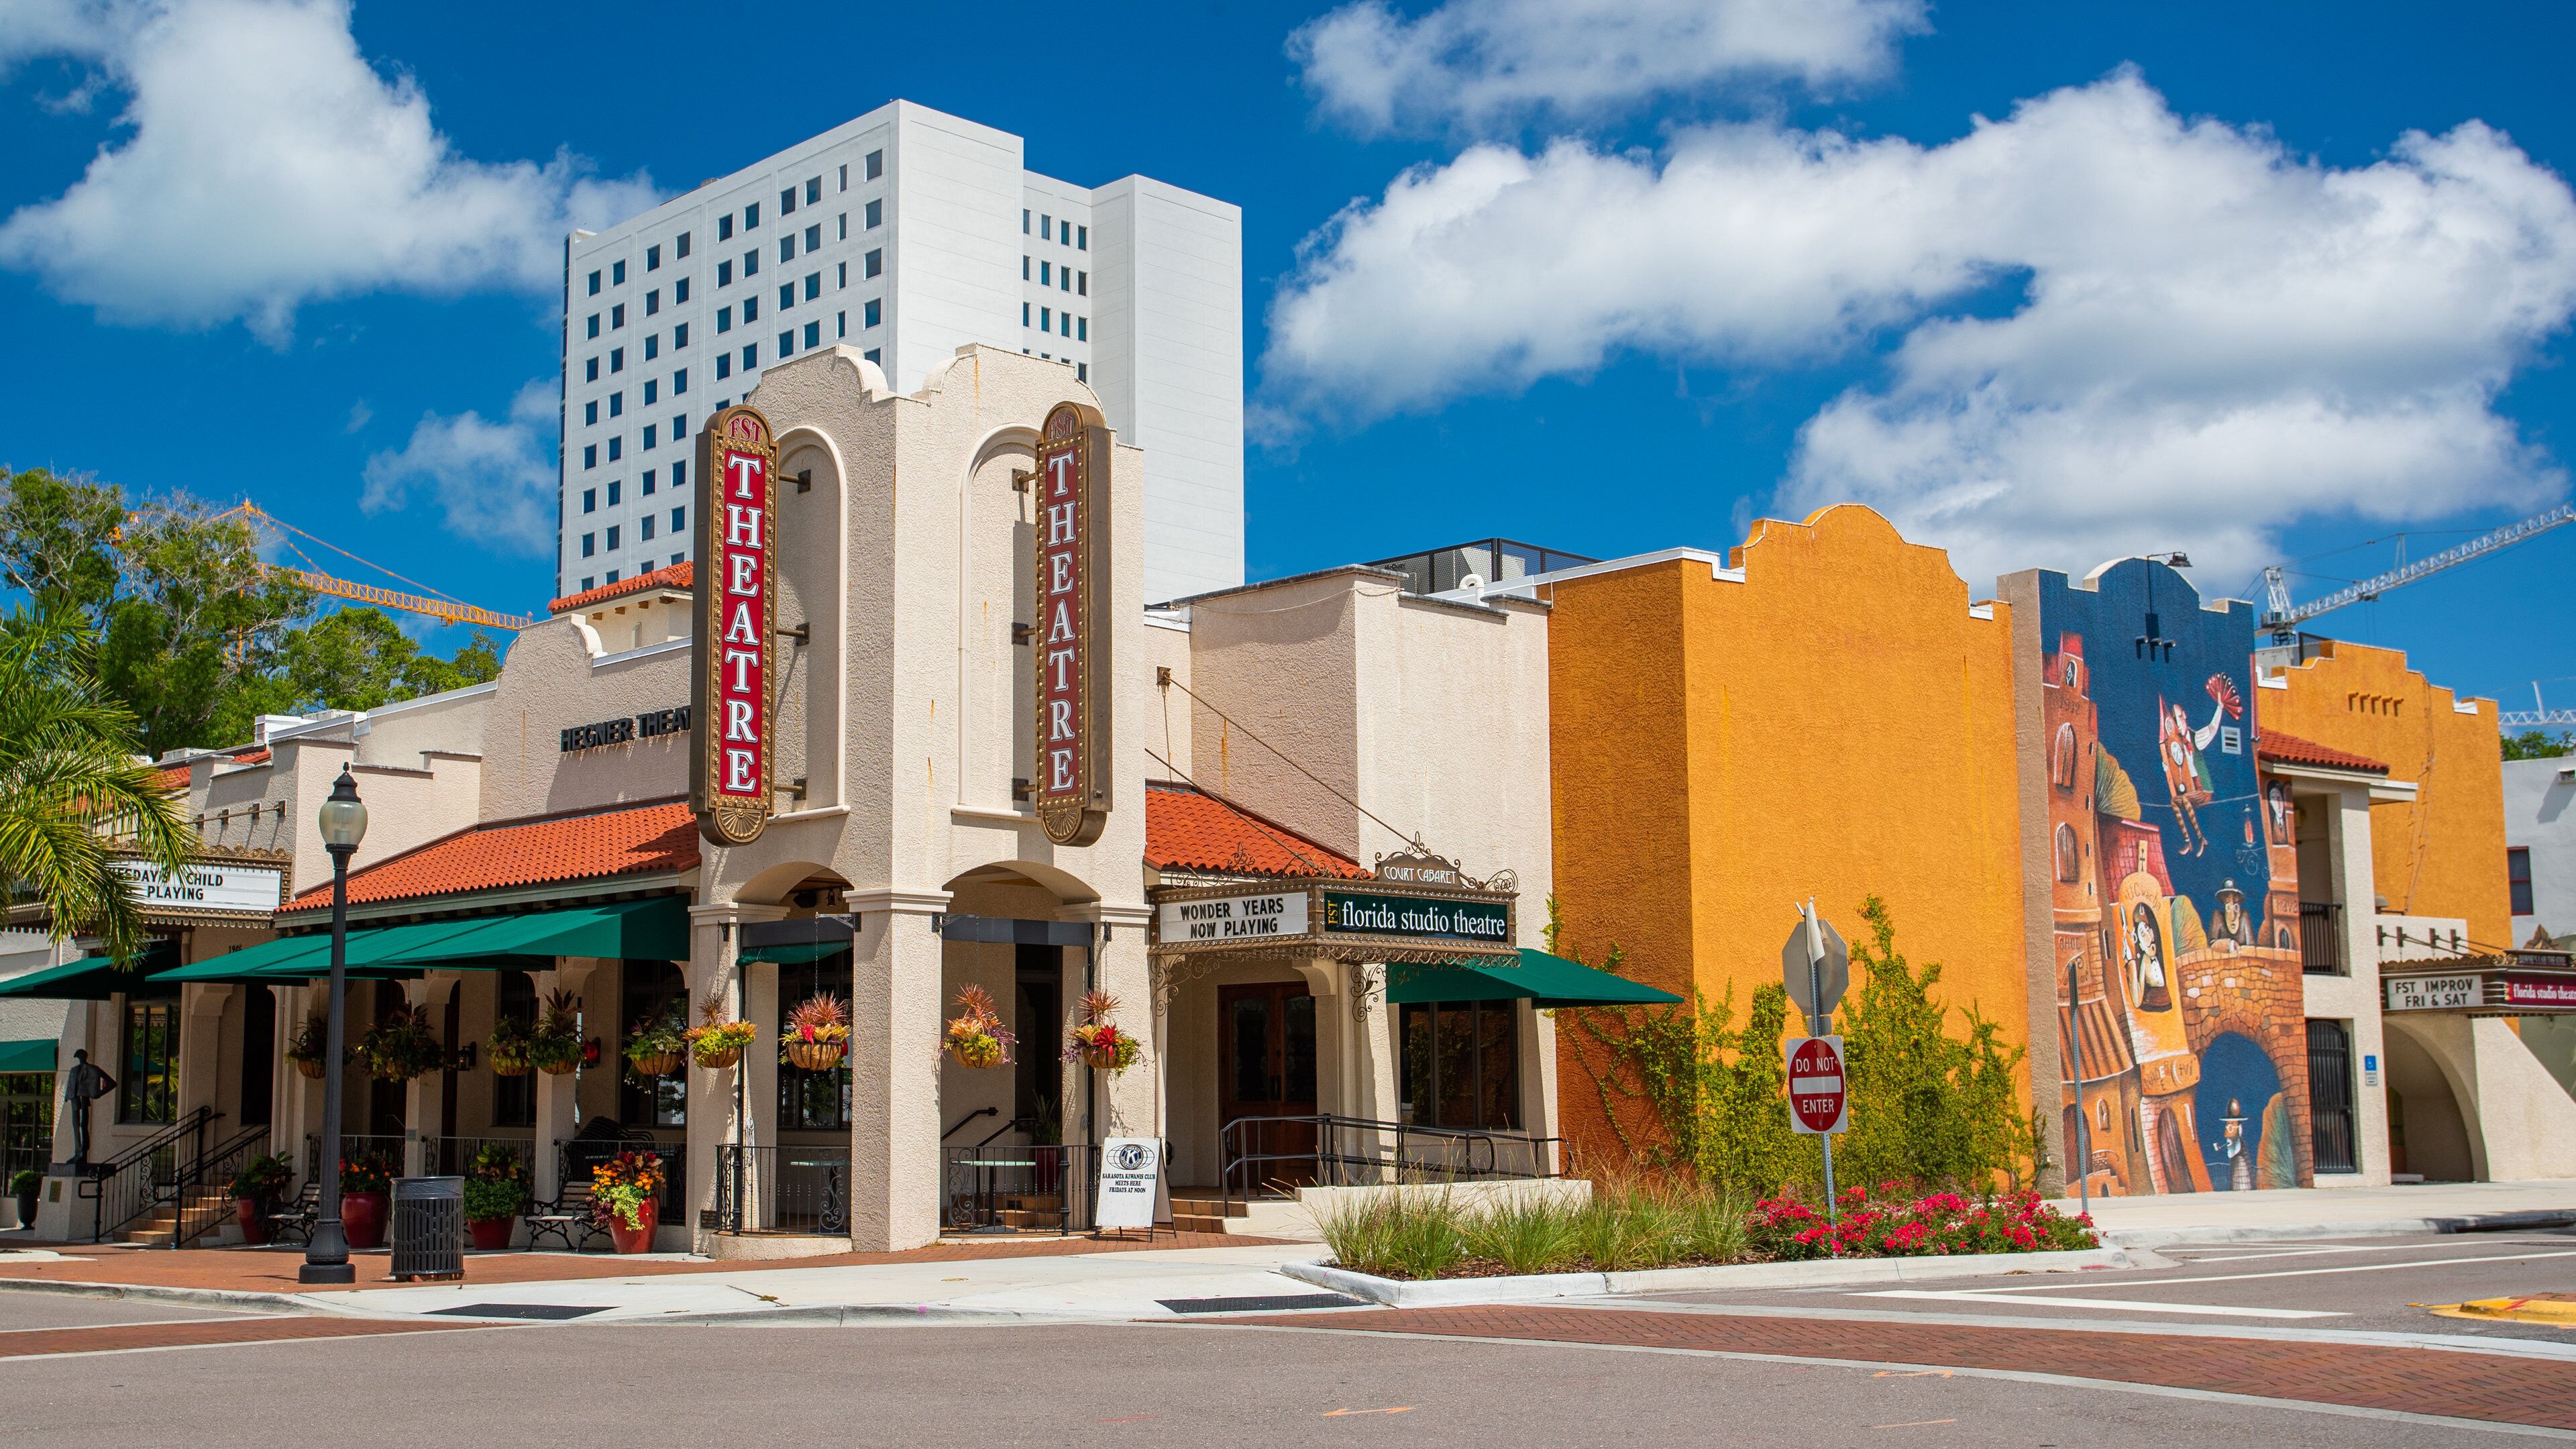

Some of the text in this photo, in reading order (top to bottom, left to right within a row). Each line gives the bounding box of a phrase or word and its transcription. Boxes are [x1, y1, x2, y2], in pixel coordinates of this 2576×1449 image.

[729, 416, 763, 443] FST
[1049, 414, 1075, 440] FST
[724, 453, 763, 793] THEATRE
[1047, 450, 1077, 792] THEATRE
[561, 718, 633, 751] HEGNER
[186, 873, 224, 887] CHILD
[1384, 866, 1456, 884] COURT CABARET
[147, 885, 204, 900] PLAYING
[1180, 898, 1284, 921] WONDER YEARS
[1328, 900, 1339, 925] FST
[1342, 900, 1505, 936] florida studio theatre
[1190, 917, 1279, 939] NOW PLAYING
[2396, 978, 2473, 994] FST IMPROV
[2513, 983, 2536, 998] florida
[2537, 985, 2557, 999] studio
[2406, 994, 2468, 1007] FRI & SAT
[1796, 1057, 1835, 1073] DO NOT
[1803, 1099, 1835, 1114] ENTER
